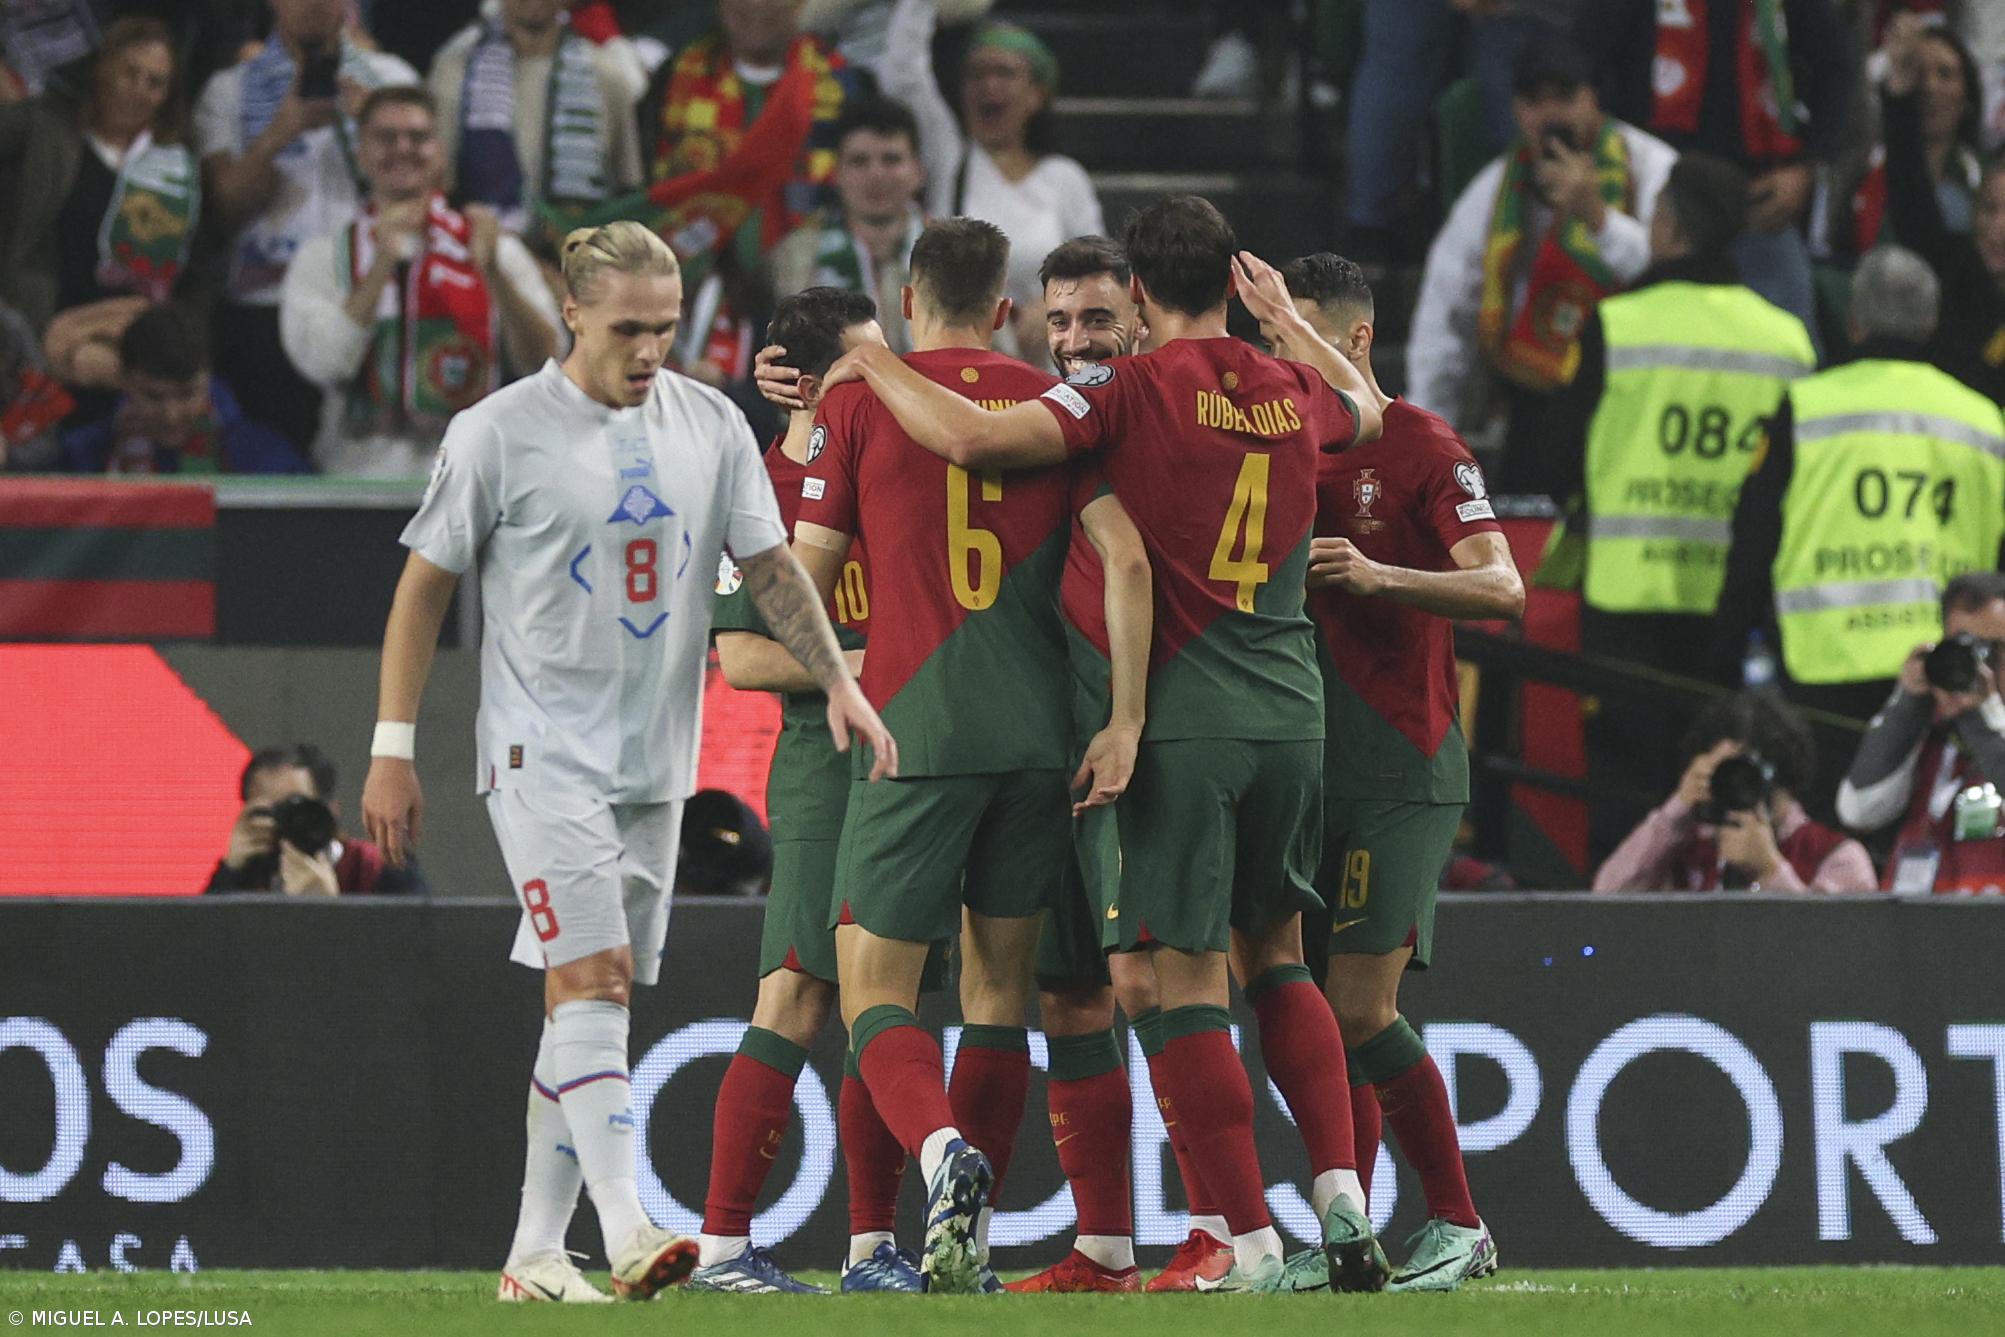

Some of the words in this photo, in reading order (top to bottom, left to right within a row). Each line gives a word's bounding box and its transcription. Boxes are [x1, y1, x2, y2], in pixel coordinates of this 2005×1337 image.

[1251, 398, 1301, 435] DIAS
[947, 462, 1002, 611] 6
[1208, 452, 1270, 615] 4
[624, 538, 658, 603] 8
[834, 560, 869, 624] 10
[521, 878, 561, 942] 8
[1339, 848, 1371, 910] 19
